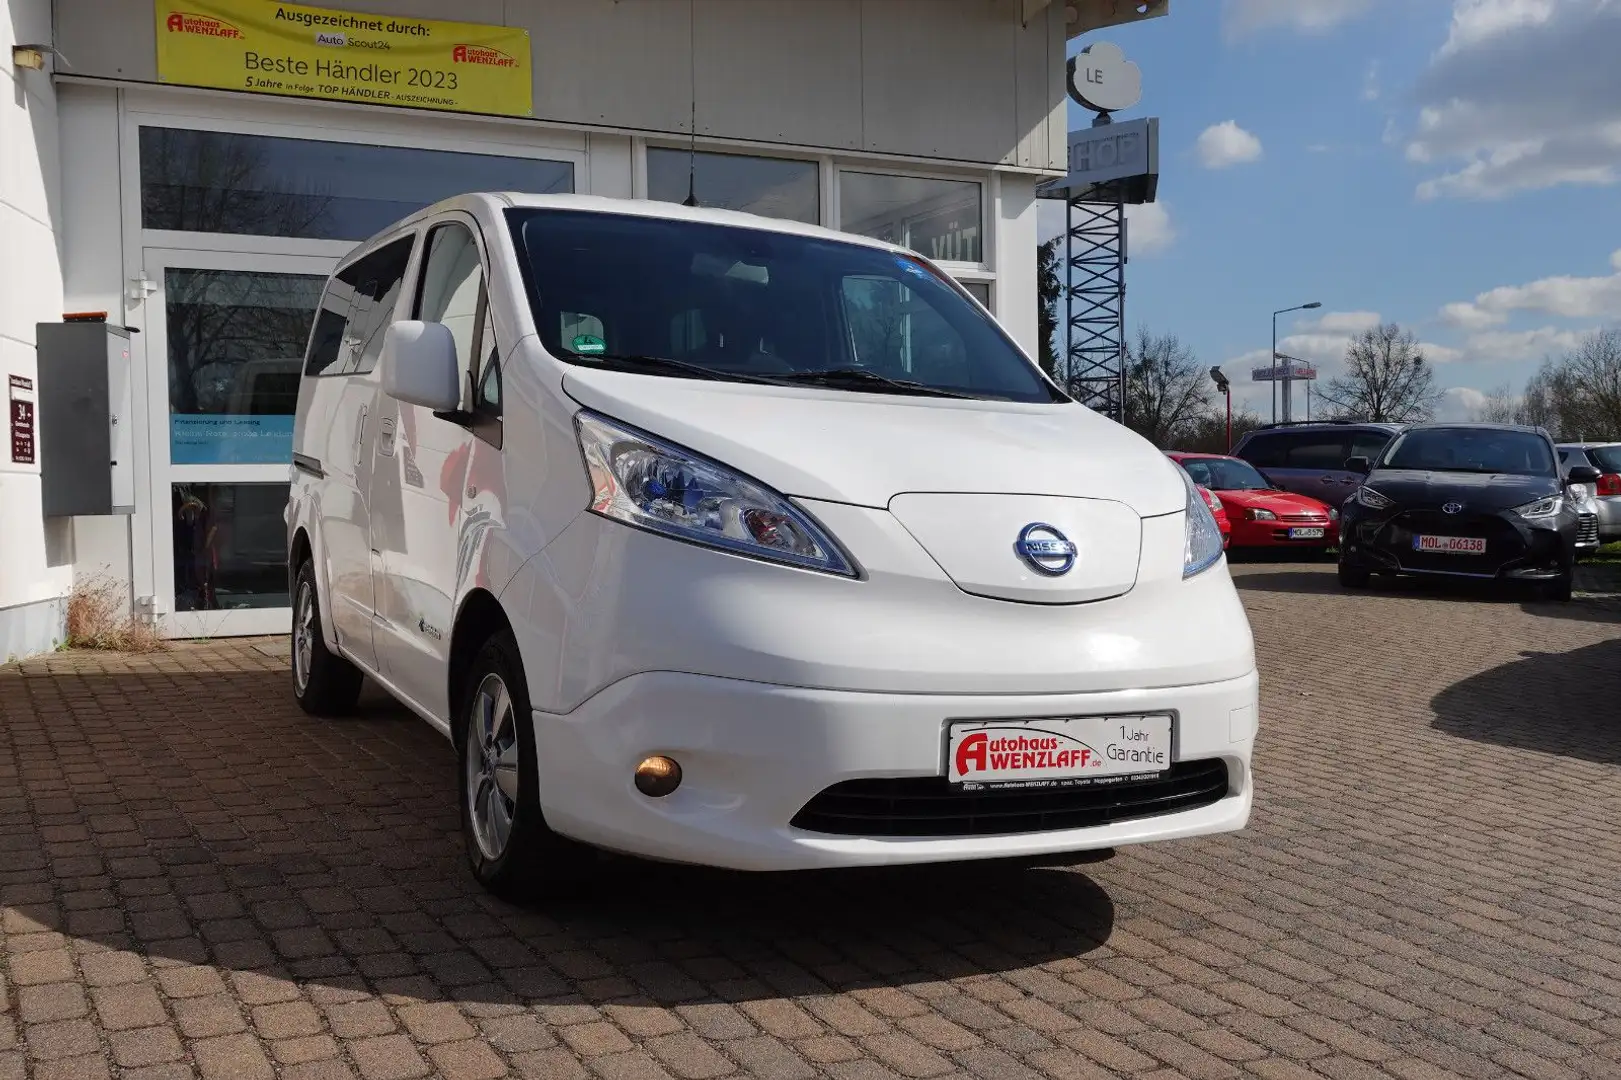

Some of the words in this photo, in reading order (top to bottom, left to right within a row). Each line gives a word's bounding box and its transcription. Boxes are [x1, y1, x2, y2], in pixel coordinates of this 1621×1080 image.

[167, 14, 221, 32] Autohaus
[275, 7, 383, 32] Ausgezeichnet
[386, 20, 430, 37] durch:
[317, 33, 344, 46] Auto
[347, 37, 391, 51] Scout24
[453, 46, 498, 64] Autohaus
[245, 51, 309, 76] Beste
[316, 58, 401, 84] Händler
[407, 67, 459, 90] 2023
[1086, 67, 1104, 85] LE
[245, 76, 253, 88] 5
[255, 77, 283, 89] Jahre
[286, 82, 293, 90] in
[294, 82, 314, 93] Folge
[318, 84, 339, 94] TOP
[341, 85, 390, 100] HÄNDLER
[1068, 132, 1139, 173] HOP
[1421, 537, 1441, 549] MOL
[1449, 538, 1483, 551] 06138
[1106, 743, 1164, 764] Garantie
